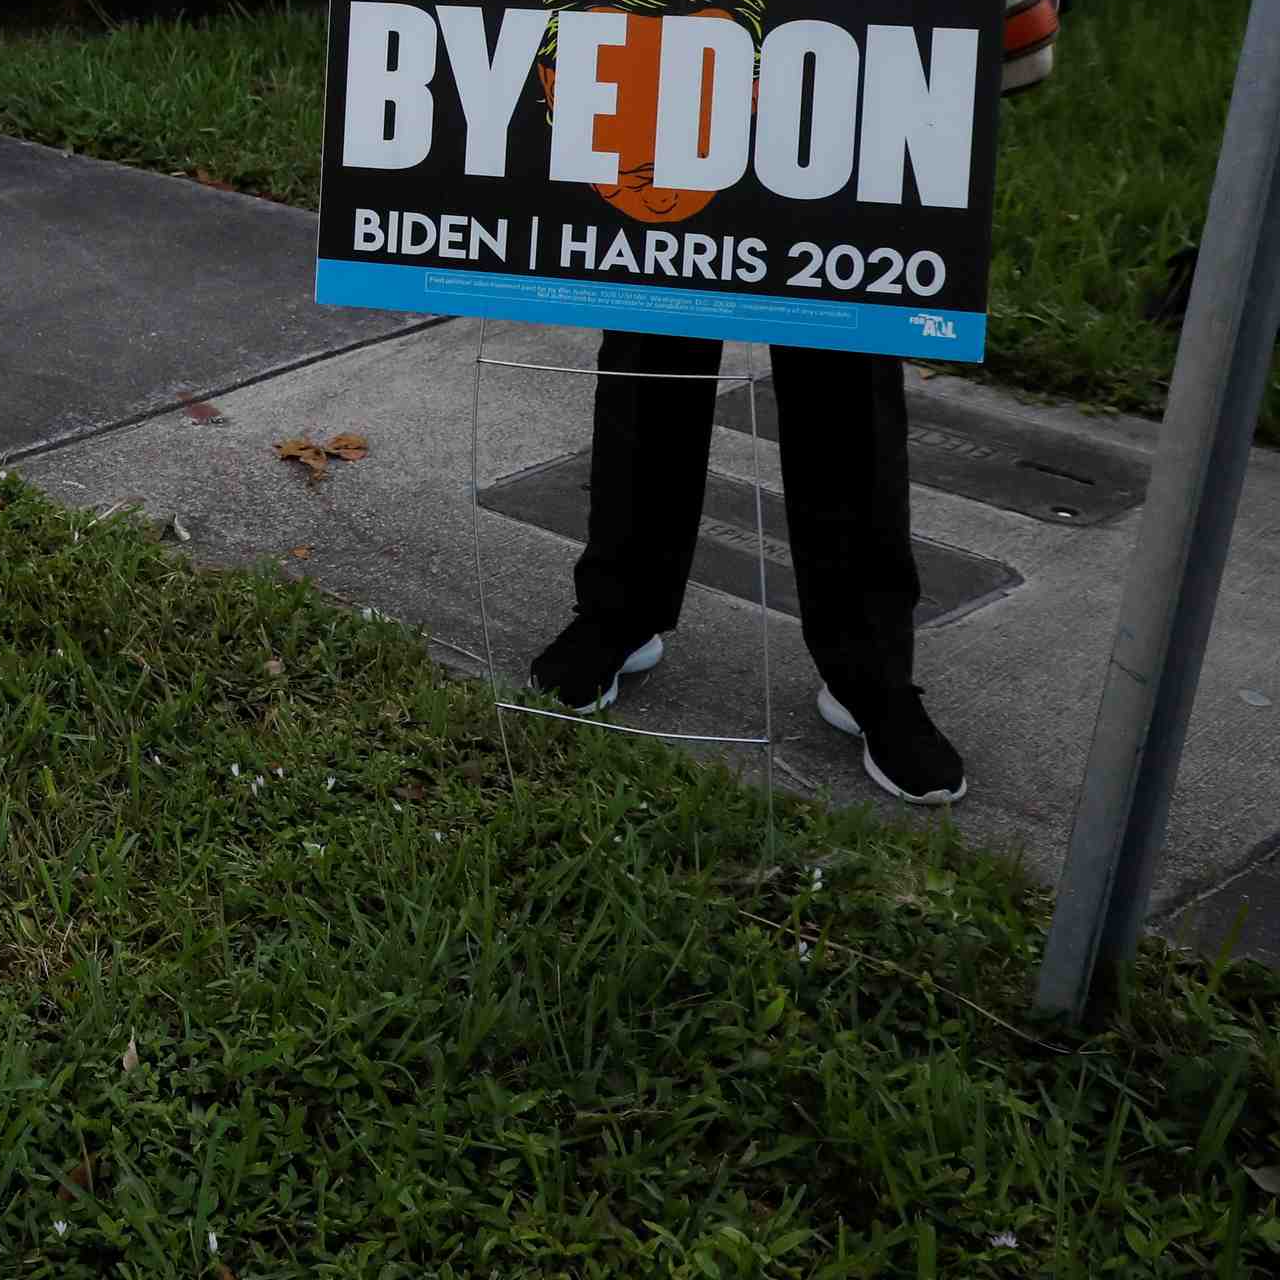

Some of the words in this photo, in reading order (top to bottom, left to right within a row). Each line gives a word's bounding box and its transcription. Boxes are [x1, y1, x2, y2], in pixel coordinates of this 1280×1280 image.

[353, 208, 508, 263] BIDEN
[560, 224, 768, 283] HARRIS
[785, 239, 946, 298] 2020
